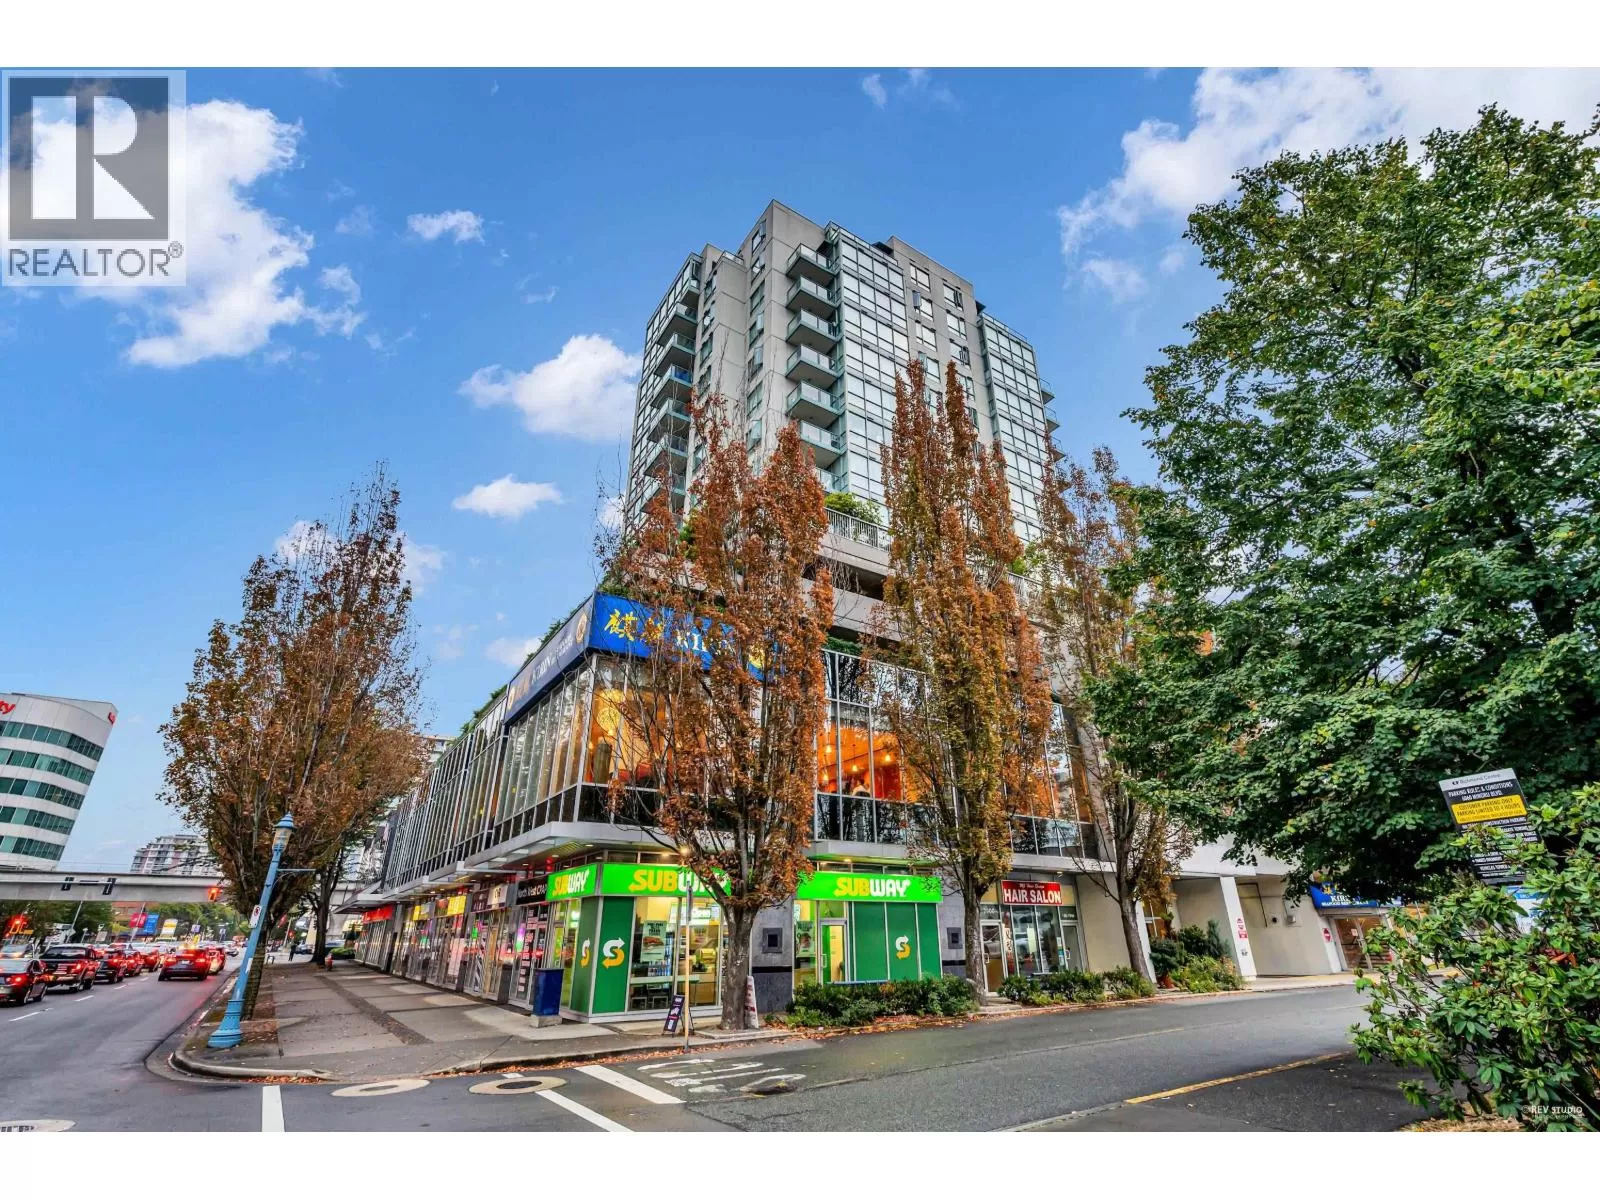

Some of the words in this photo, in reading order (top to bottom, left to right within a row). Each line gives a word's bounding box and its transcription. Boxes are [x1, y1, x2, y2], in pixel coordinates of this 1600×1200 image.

[1448, 789, 1467, 797] PARKING
[1485, 781, 1513, 791] CONDITIONS
[552, 868, 590, 896] SUBWAY
[834, 877, 911, 898] SUBWAY
[1003, 888, 1028, 903] HAIR
[1029, 889, 1061, 904] SALON
